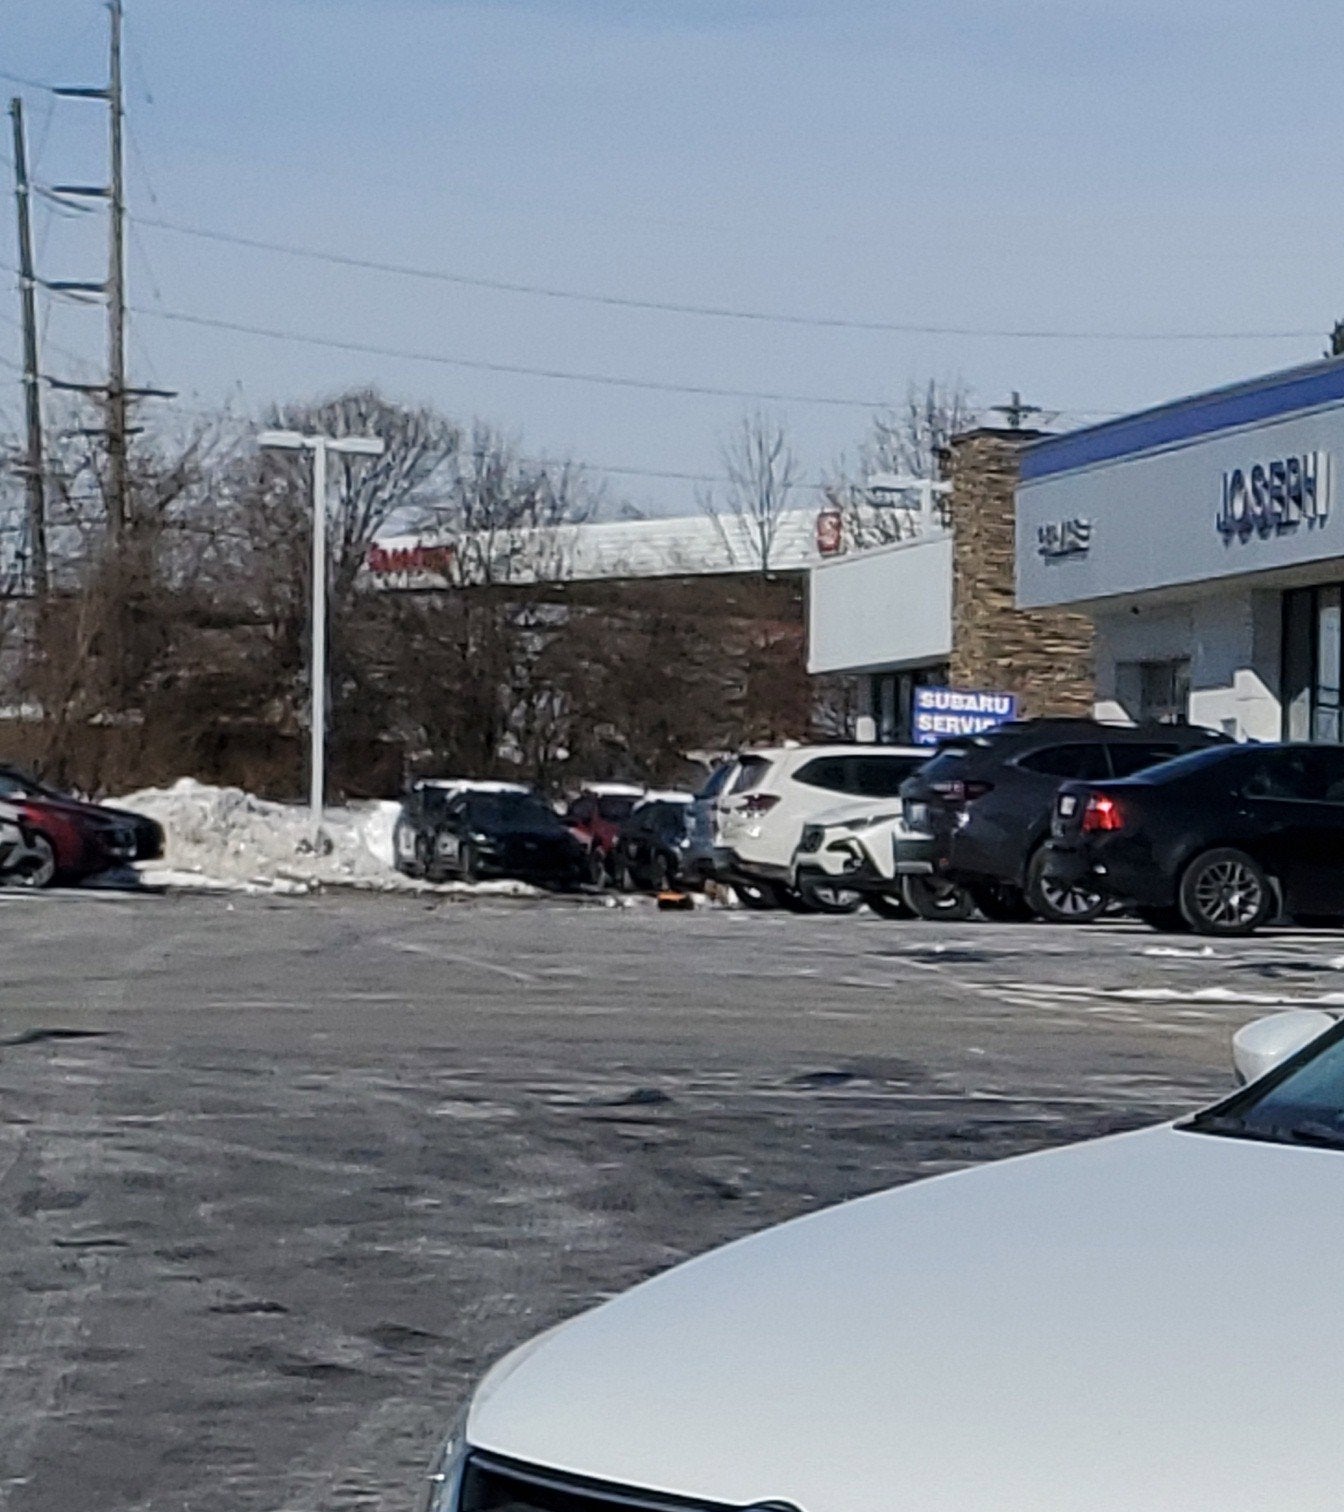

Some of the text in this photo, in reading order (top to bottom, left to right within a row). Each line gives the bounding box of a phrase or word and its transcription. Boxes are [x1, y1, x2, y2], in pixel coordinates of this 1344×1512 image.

[1216, 450, 1330, 538] JOSEPH
[918, 691, 1010, 715] SUBARU
[918, 713, 1003, 736] SERVI
